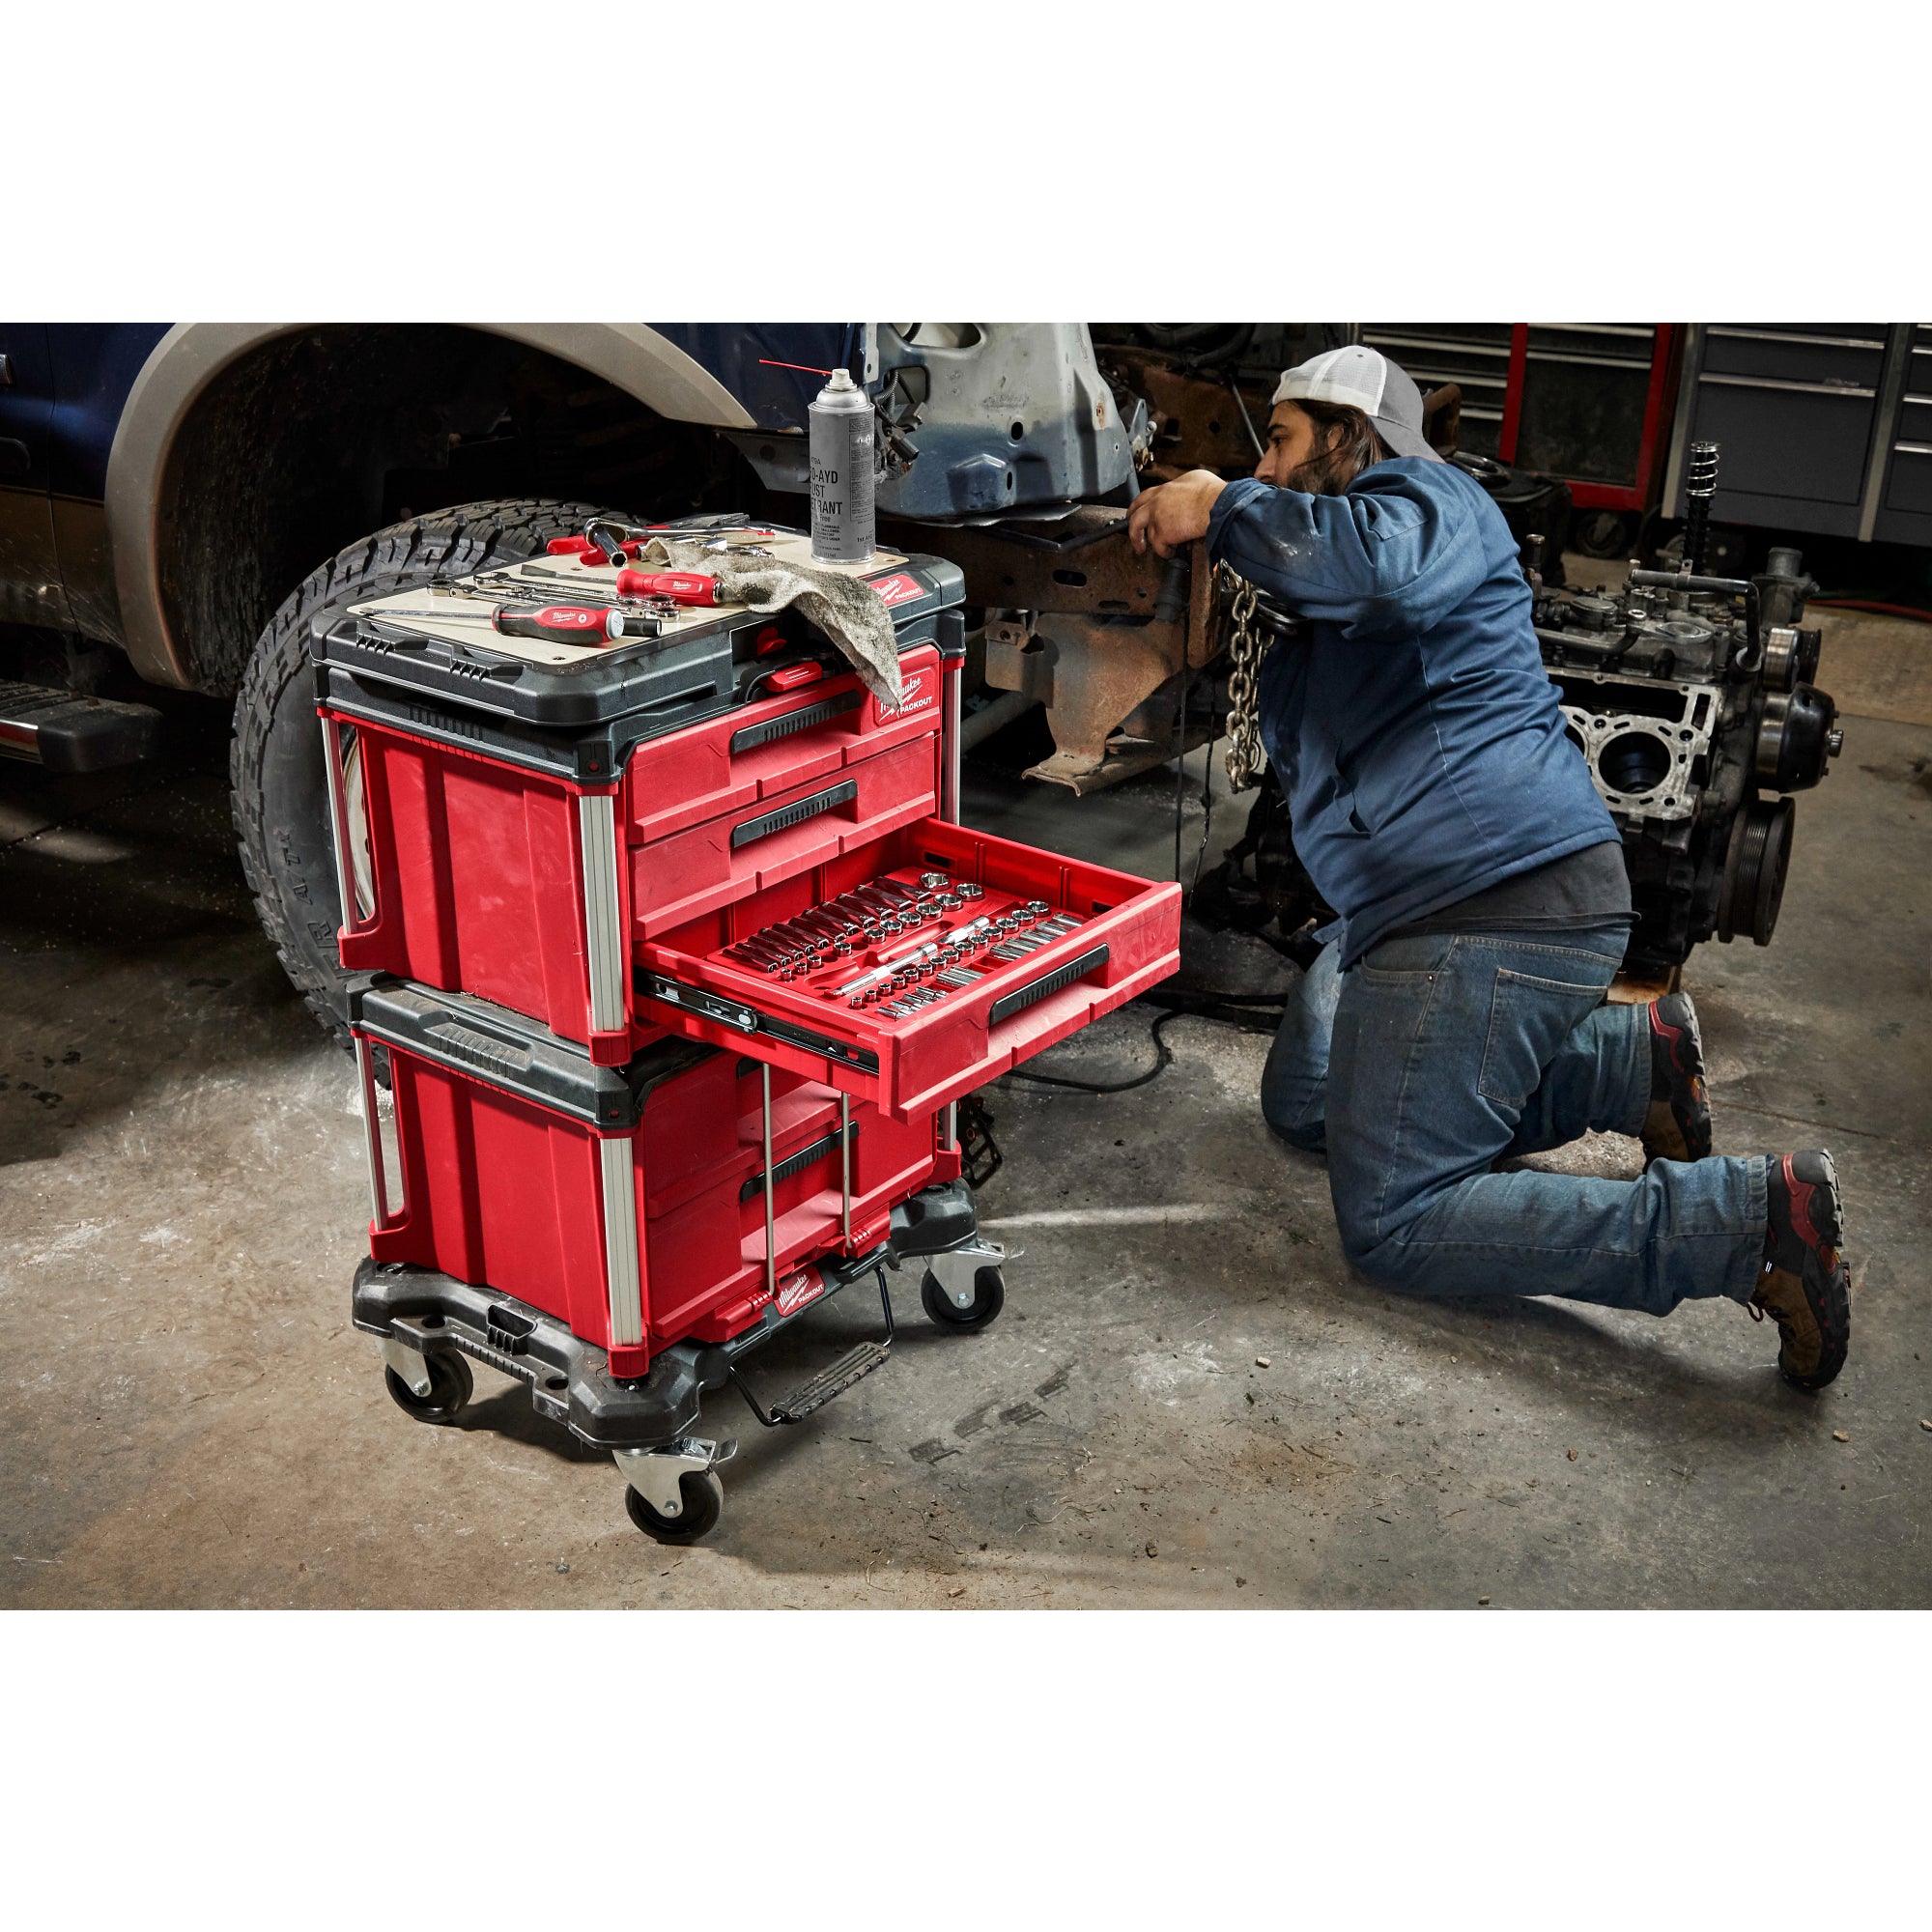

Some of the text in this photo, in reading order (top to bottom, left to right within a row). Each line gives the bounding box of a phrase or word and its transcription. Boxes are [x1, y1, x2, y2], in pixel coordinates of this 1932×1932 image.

[810, 482, 826, 498] UST
[899, 696, 933, 715] PACKOUT
[779, 1274, 809, 1308] Milwaukee
[798, 1284, 824, 1304] PACKOUT
